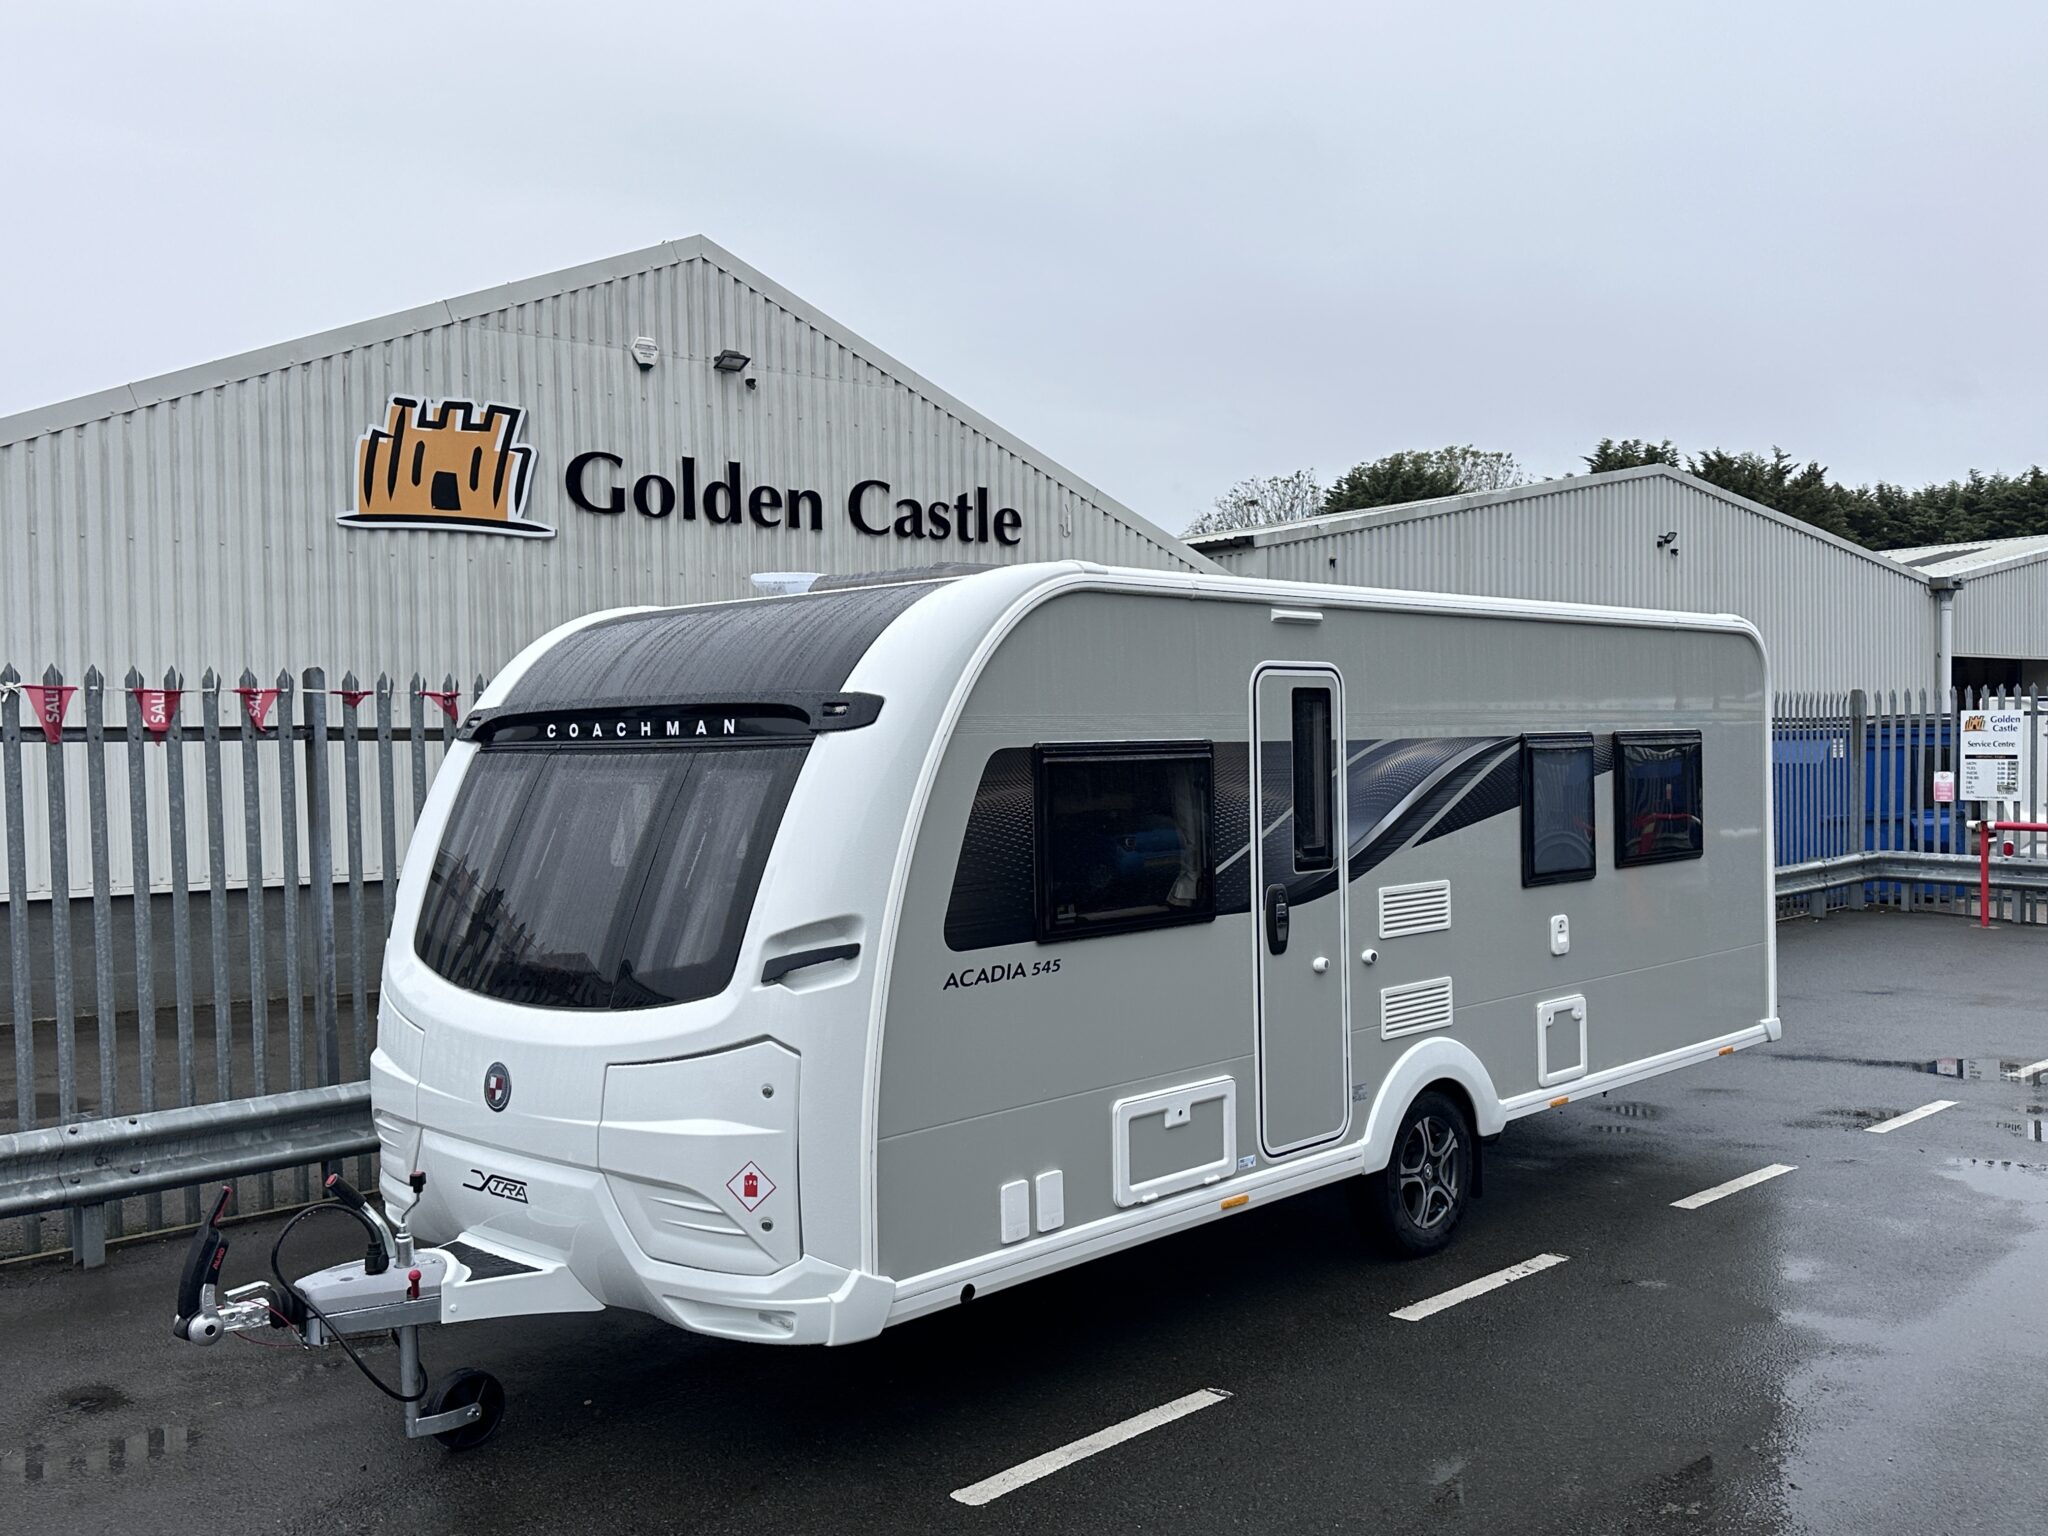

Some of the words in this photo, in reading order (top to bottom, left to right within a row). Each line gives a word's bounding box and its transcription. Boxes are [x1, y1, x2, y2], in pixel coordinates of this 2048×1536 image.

[566, 452, 823, 530] Golden
[848, 480, 1022, 545] Castle
[1990, 714, 2020, 723] Golden
[547, 718, 735, 738] COACHMAN
[1992, 724, 2018, 732] Castle
[1967, 740, 1991, 748] Service
[1992, 740, 2016, 748] Centre
[943, 962, 1027, 990] ACADIA
[1031, 958, 1061, 976] 545
